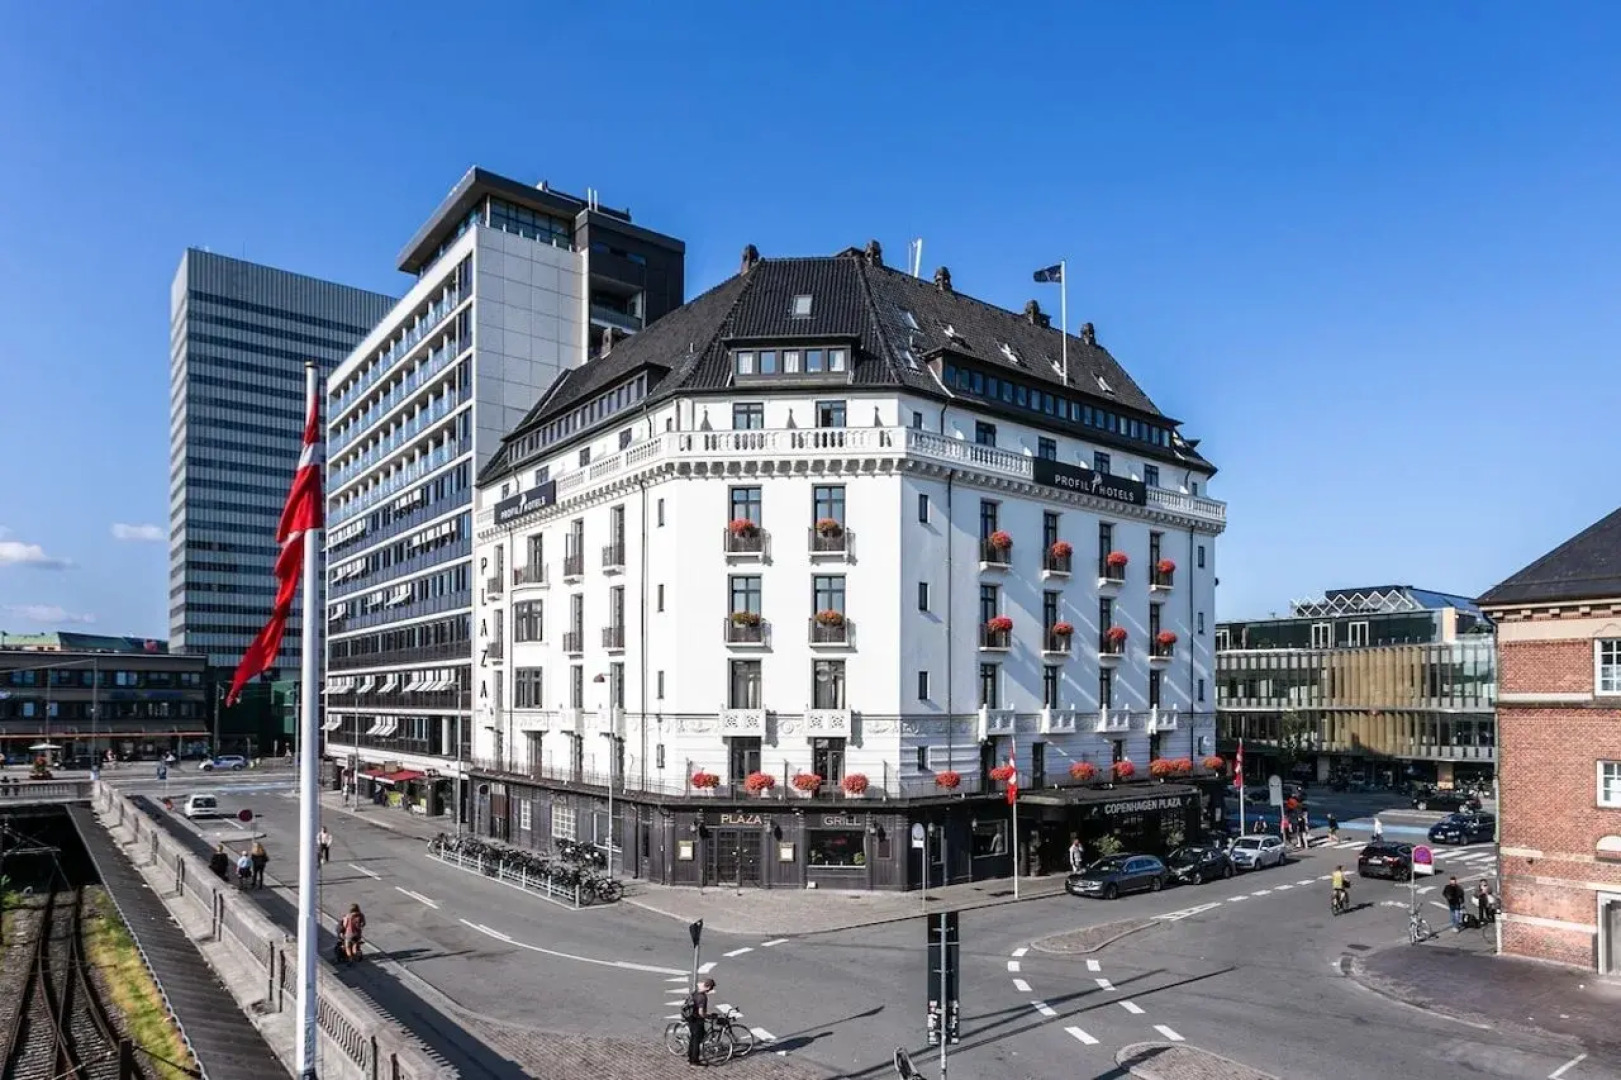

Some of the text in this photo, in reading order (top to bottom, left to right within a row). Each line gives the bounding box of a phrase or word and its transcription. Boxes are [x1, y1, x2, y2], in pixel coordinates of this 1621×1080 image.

[1054, 474, 1134, 501] PROFIL HOTELS
[480, 556, 488, 699] PLAZA
[1104, 798, 1181, 814] COPENHAGEN PLAZA
[720, 813, 763, 825] PLAZA
[823, 816, 862, 827] GRILL
